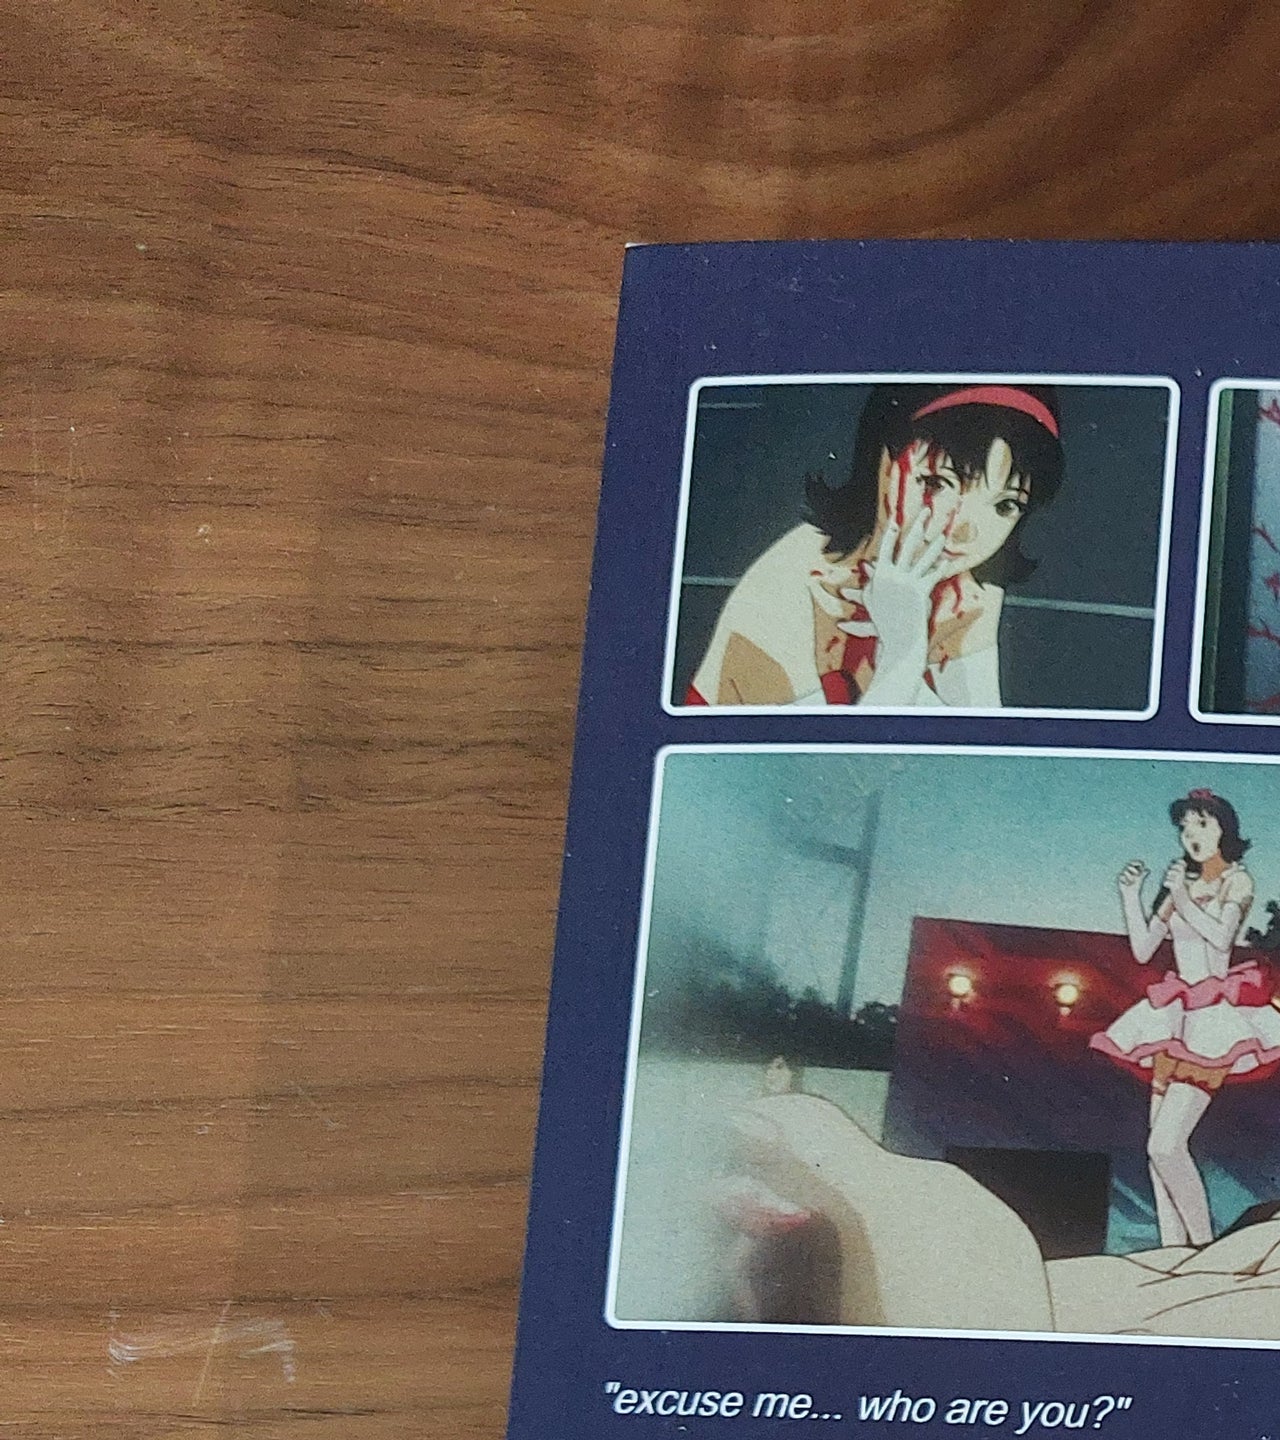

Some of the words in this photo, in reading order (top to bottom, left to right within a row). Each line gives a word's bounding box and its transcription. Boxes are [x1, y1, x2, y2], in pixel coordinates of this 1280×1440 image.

[604, 1381, 744, 1417] "excuse
[751, 1392, 842, 1419] me...
[858, 1389, 936, 1422] who
[944, 1397, 1009, 1425] are
[1013, 1394, 1133, 1435] you?"
